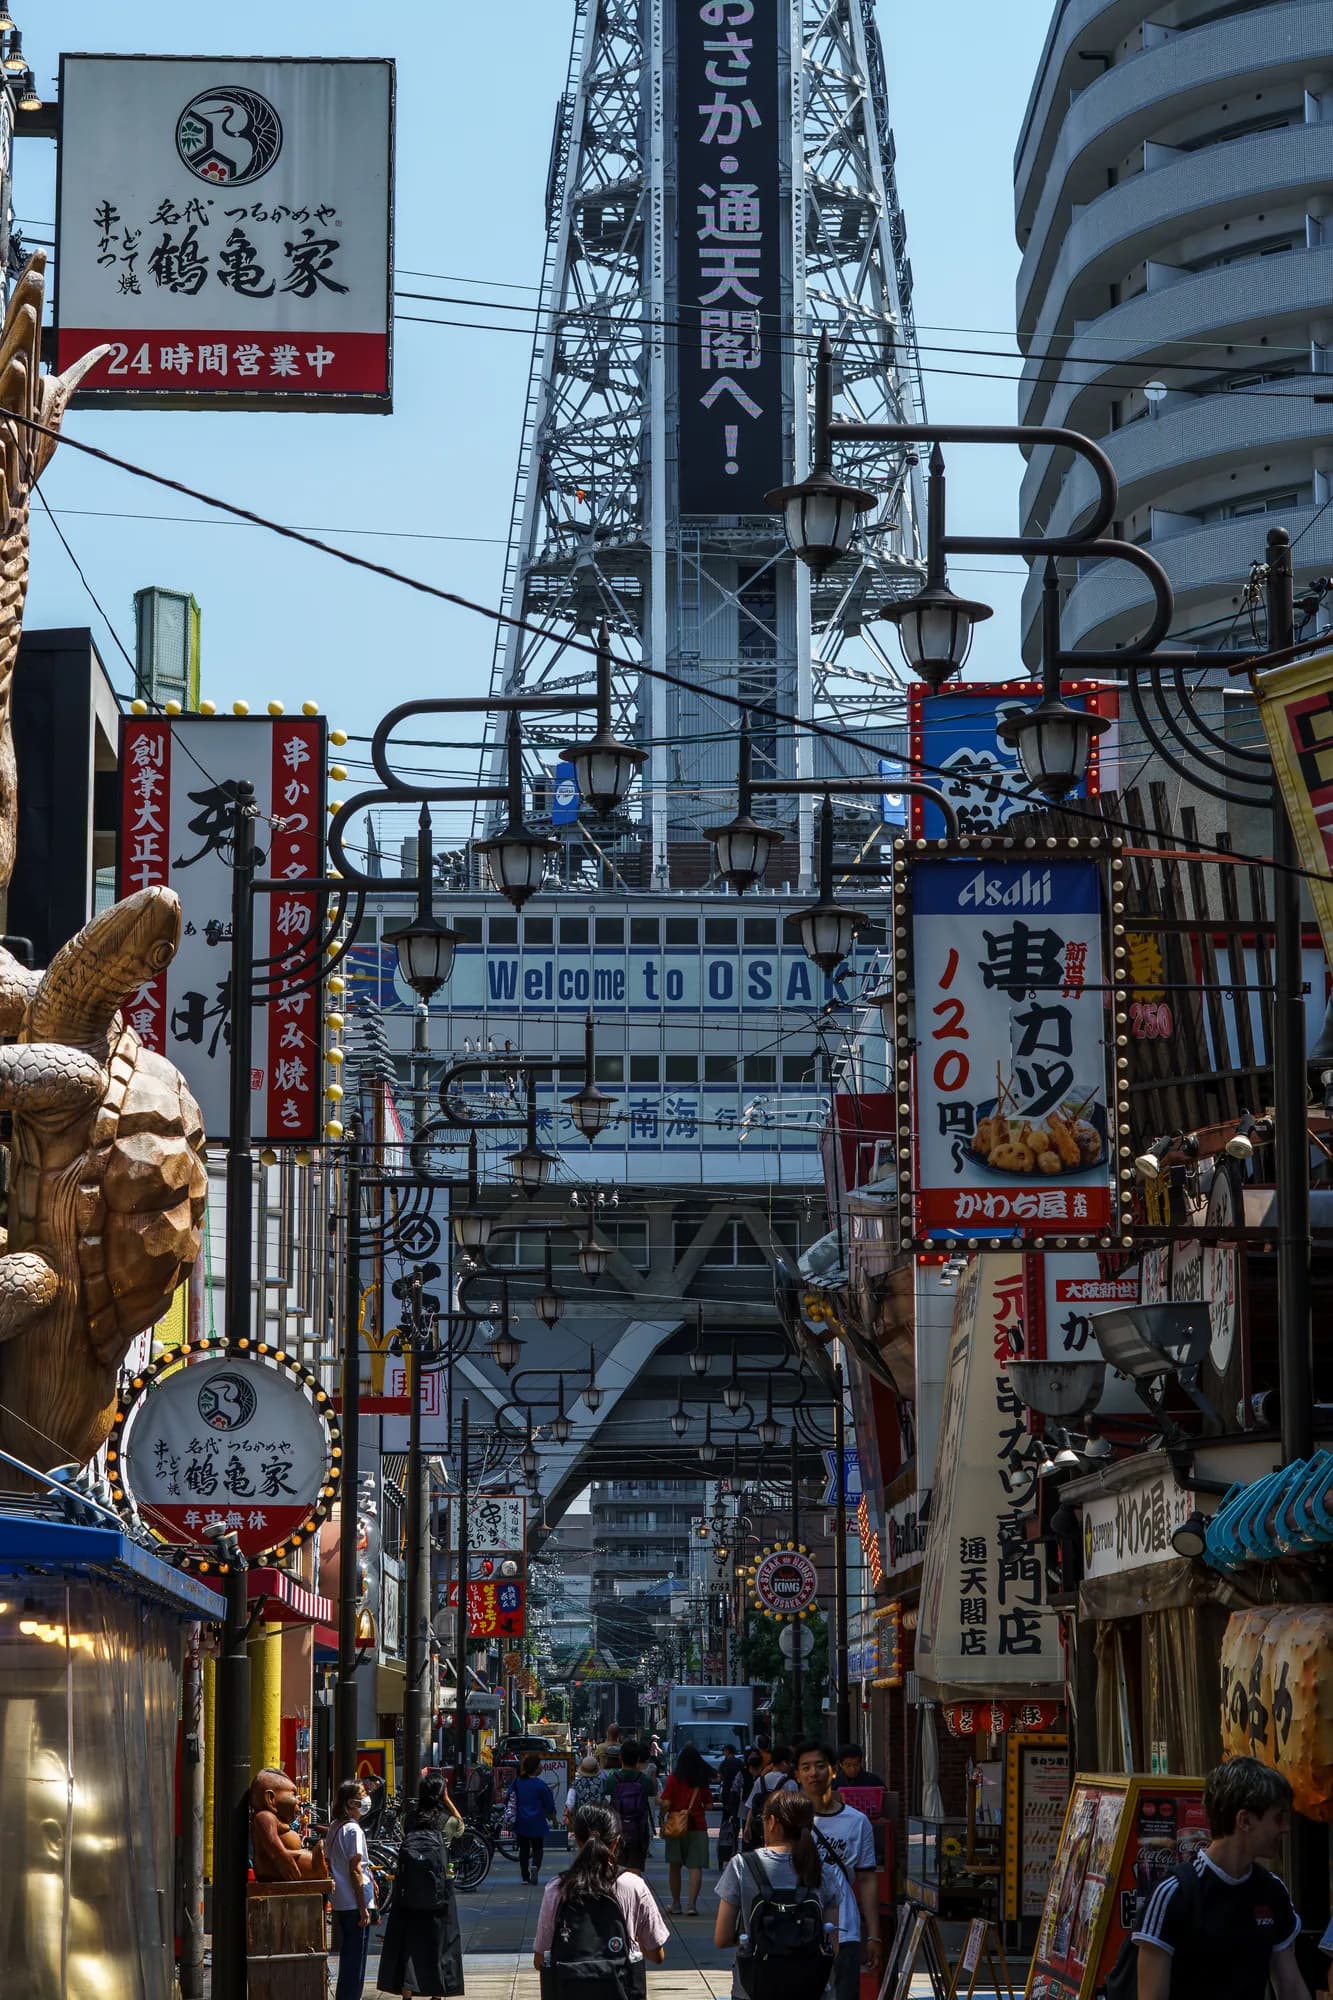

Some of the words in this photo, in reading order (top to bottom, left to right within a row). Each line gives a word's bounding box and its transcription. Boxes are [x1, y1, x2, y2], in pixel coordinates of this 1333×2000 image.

[149, 198, 214, 226] 名代
[224, 203, 337, 228] つるかめや
[93, 200, 121, 269] 串かつ
[117, 227, 143, 295] どて焼
[147, 225, 351, 299] 鶴亀家
[106, 341, 336, 378] 24時間営業中
[958, 870, 1053, 909] Asahi
[274, 736, 312, 1128] 串かつ・名物お好み焼き
[488, 959, 625, 1001] Welcome
[643, 960, 684, 1001] to
[1062, 940, 1089, 1000] 新世界
[978, 920, 1074, 1121] 串カツ
[1129, 1002, 1173, 1039] 250
[629, 1098, 698, 1139] 南海
[954, 1190, 1069, 1220] かわち屋
[1073, 1191, 1088, 1219] 本店
[153, 1439, 169, 1479] 串かつ
[184, 1437, 222, 1455] 名代
[227, 1440, 292, 1455] つるかめや
[167, 1456, 182, 1496] どて焼
[184, 1454, 299, 1498] 鶴亀家
[183, 1509, 269, 1531] 年中無休
[760, 1556, 781, 1584] STEAK
[792, 1556, 814, 1583] HOUSE
[774, 1582, 801, 1593] KING
[773, 1598, 802, 1609] OSAKA
[959, 1536, 988, 1656] 通天閣店
